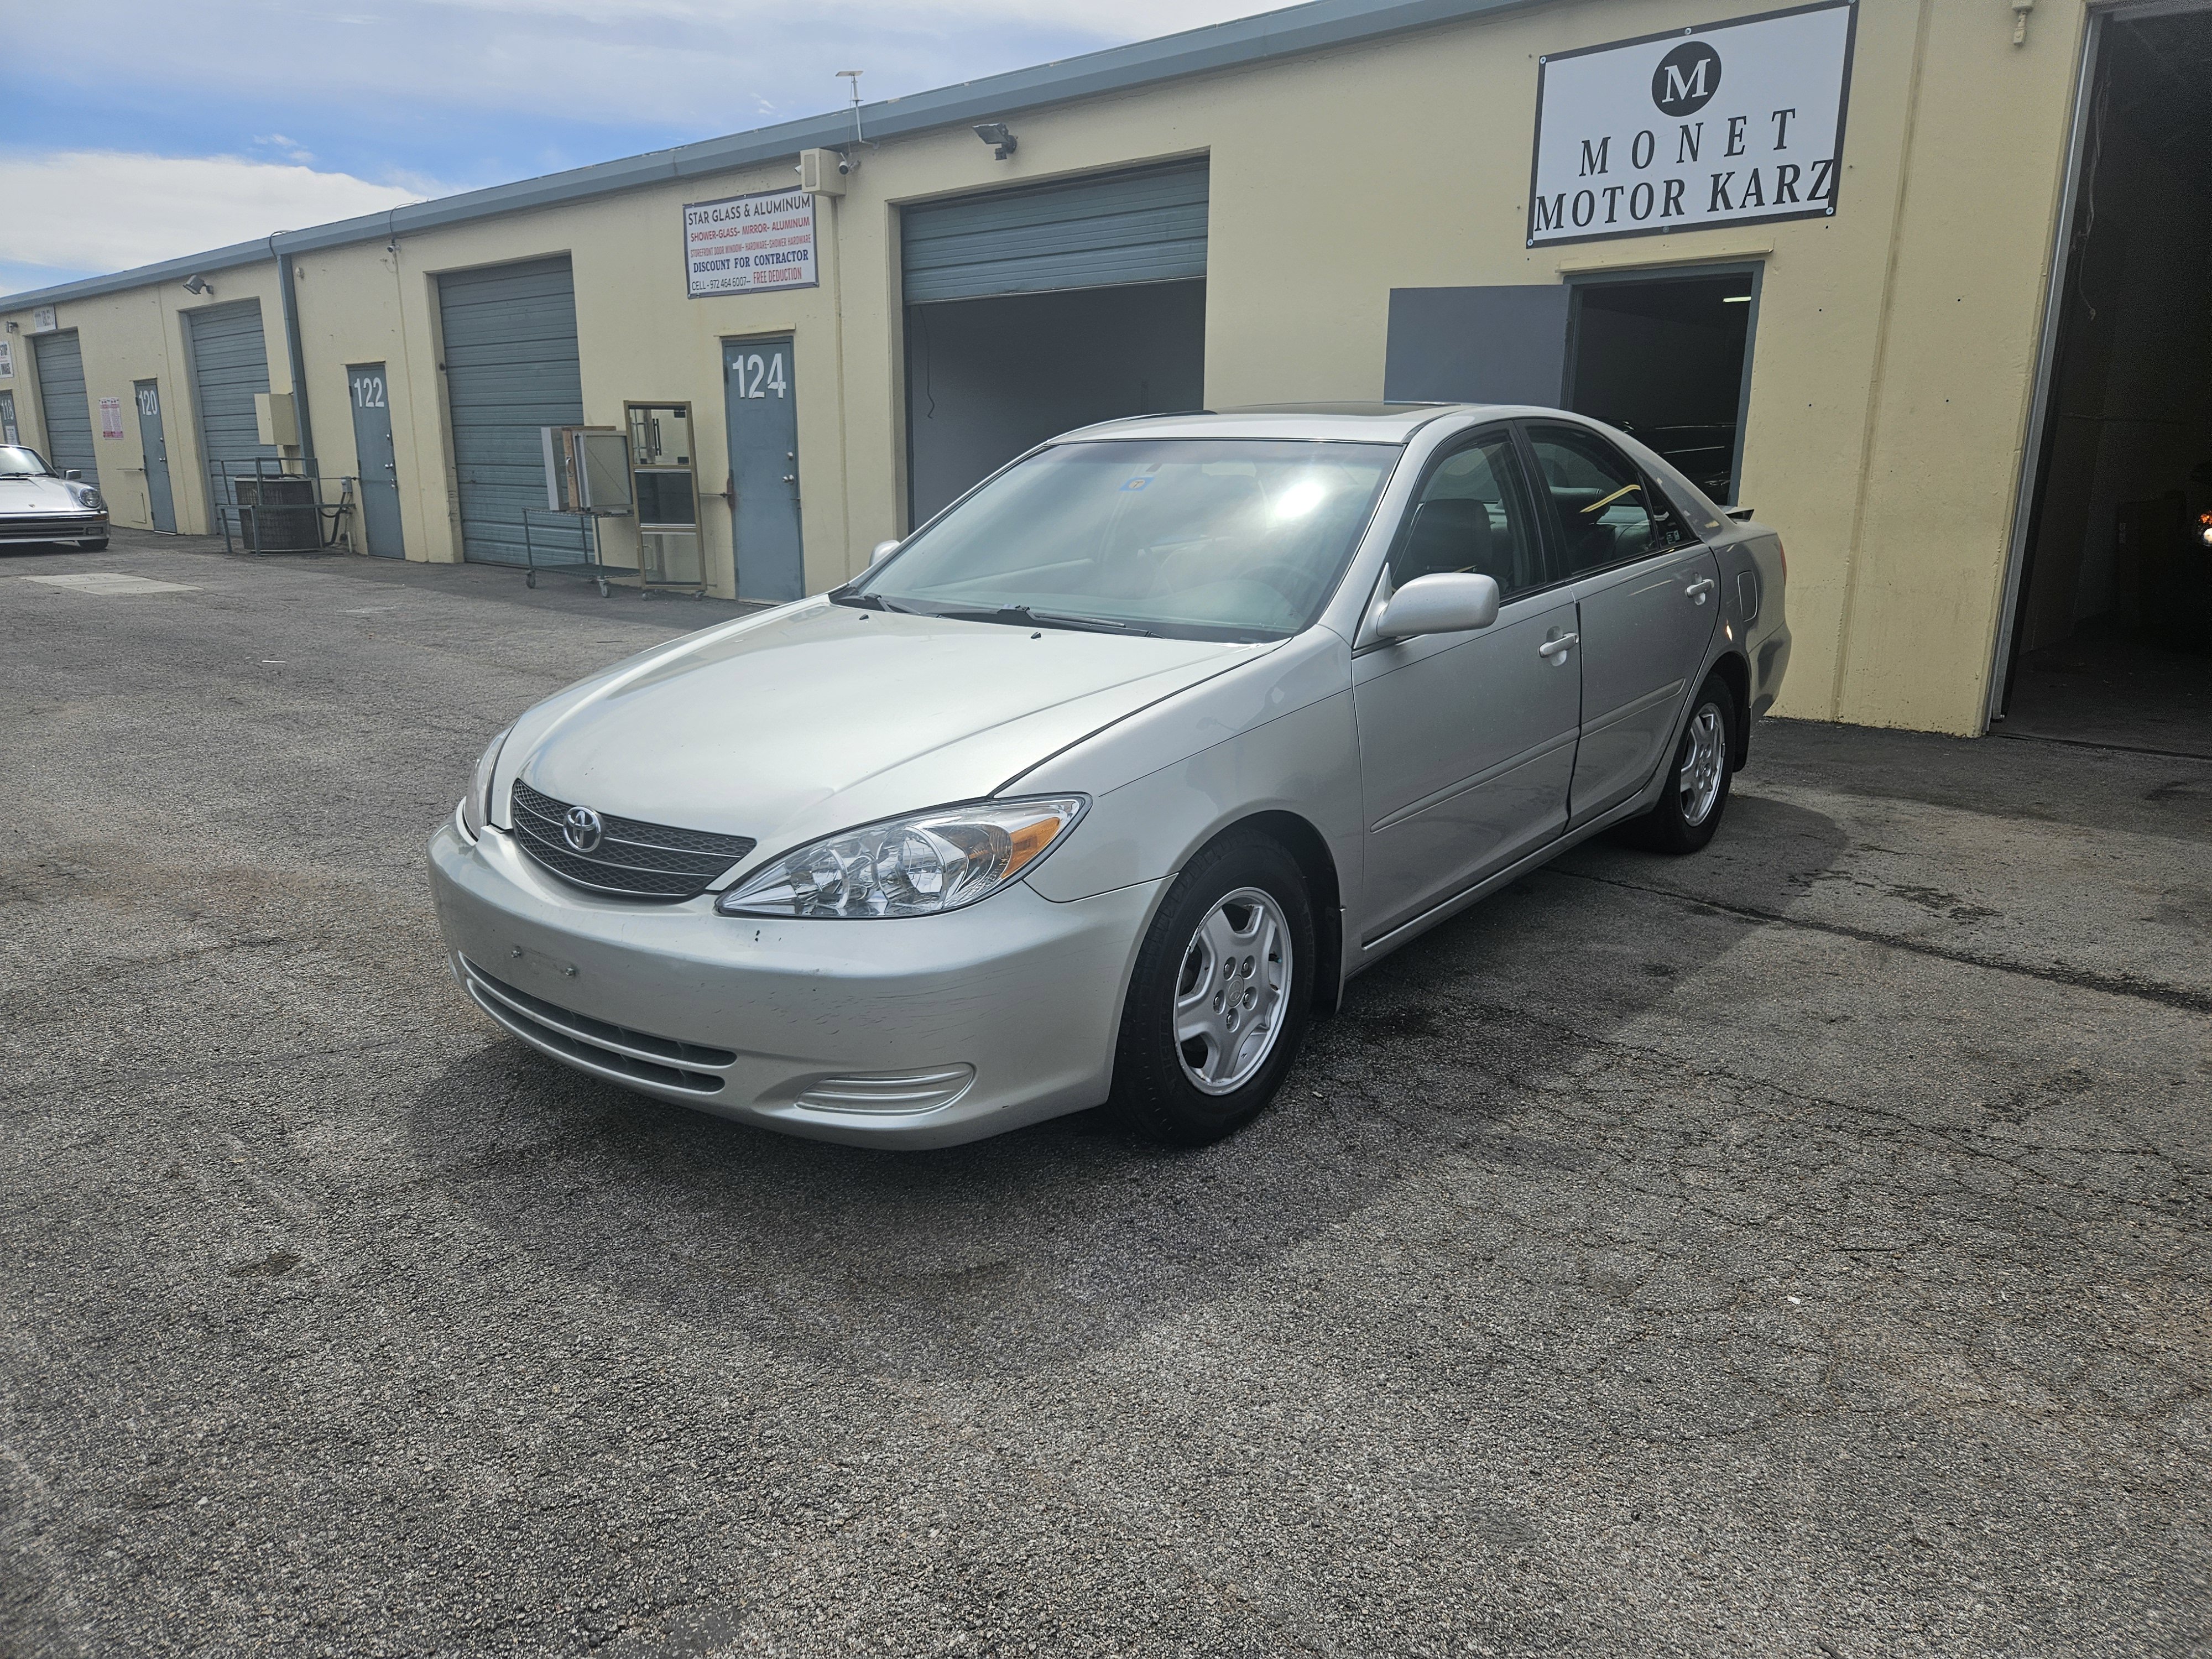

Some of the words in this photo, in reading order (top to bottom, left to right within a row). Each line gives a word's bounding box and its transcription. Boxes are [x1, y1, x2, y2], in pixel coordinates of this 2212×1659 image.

[1661, 58, 1712, 103] M
[1579, 108, 1796, 177] MONET
[688, 211, 709, 226] STAR
[712, 206, 741, 222] GLASS
[744, 204, 750, 217] &
[754, 195, 810, 216] ALUMINUM
[1534, 179, 1686, 232] MOTOR
[1707, 159, 1833, 212] KARZ
[772, 216, 810, 231] ALUMINUM
[787, 234, 811, 246] HARDWARE
[693, 259, 731, 273] DISCOUNT
[734, 257, 750, 269] FOR
[754, 249, 808, 266] CONTRACTOR
[721, 278, 731, 288] 464
[753, 270, 767, 284] FREE
[768, 267, 802, 283] DEDUCTION
[732, 353, 786, 398] 124
[139, 390, 157, 415] 120
[354, 377, 384, 407] 122
